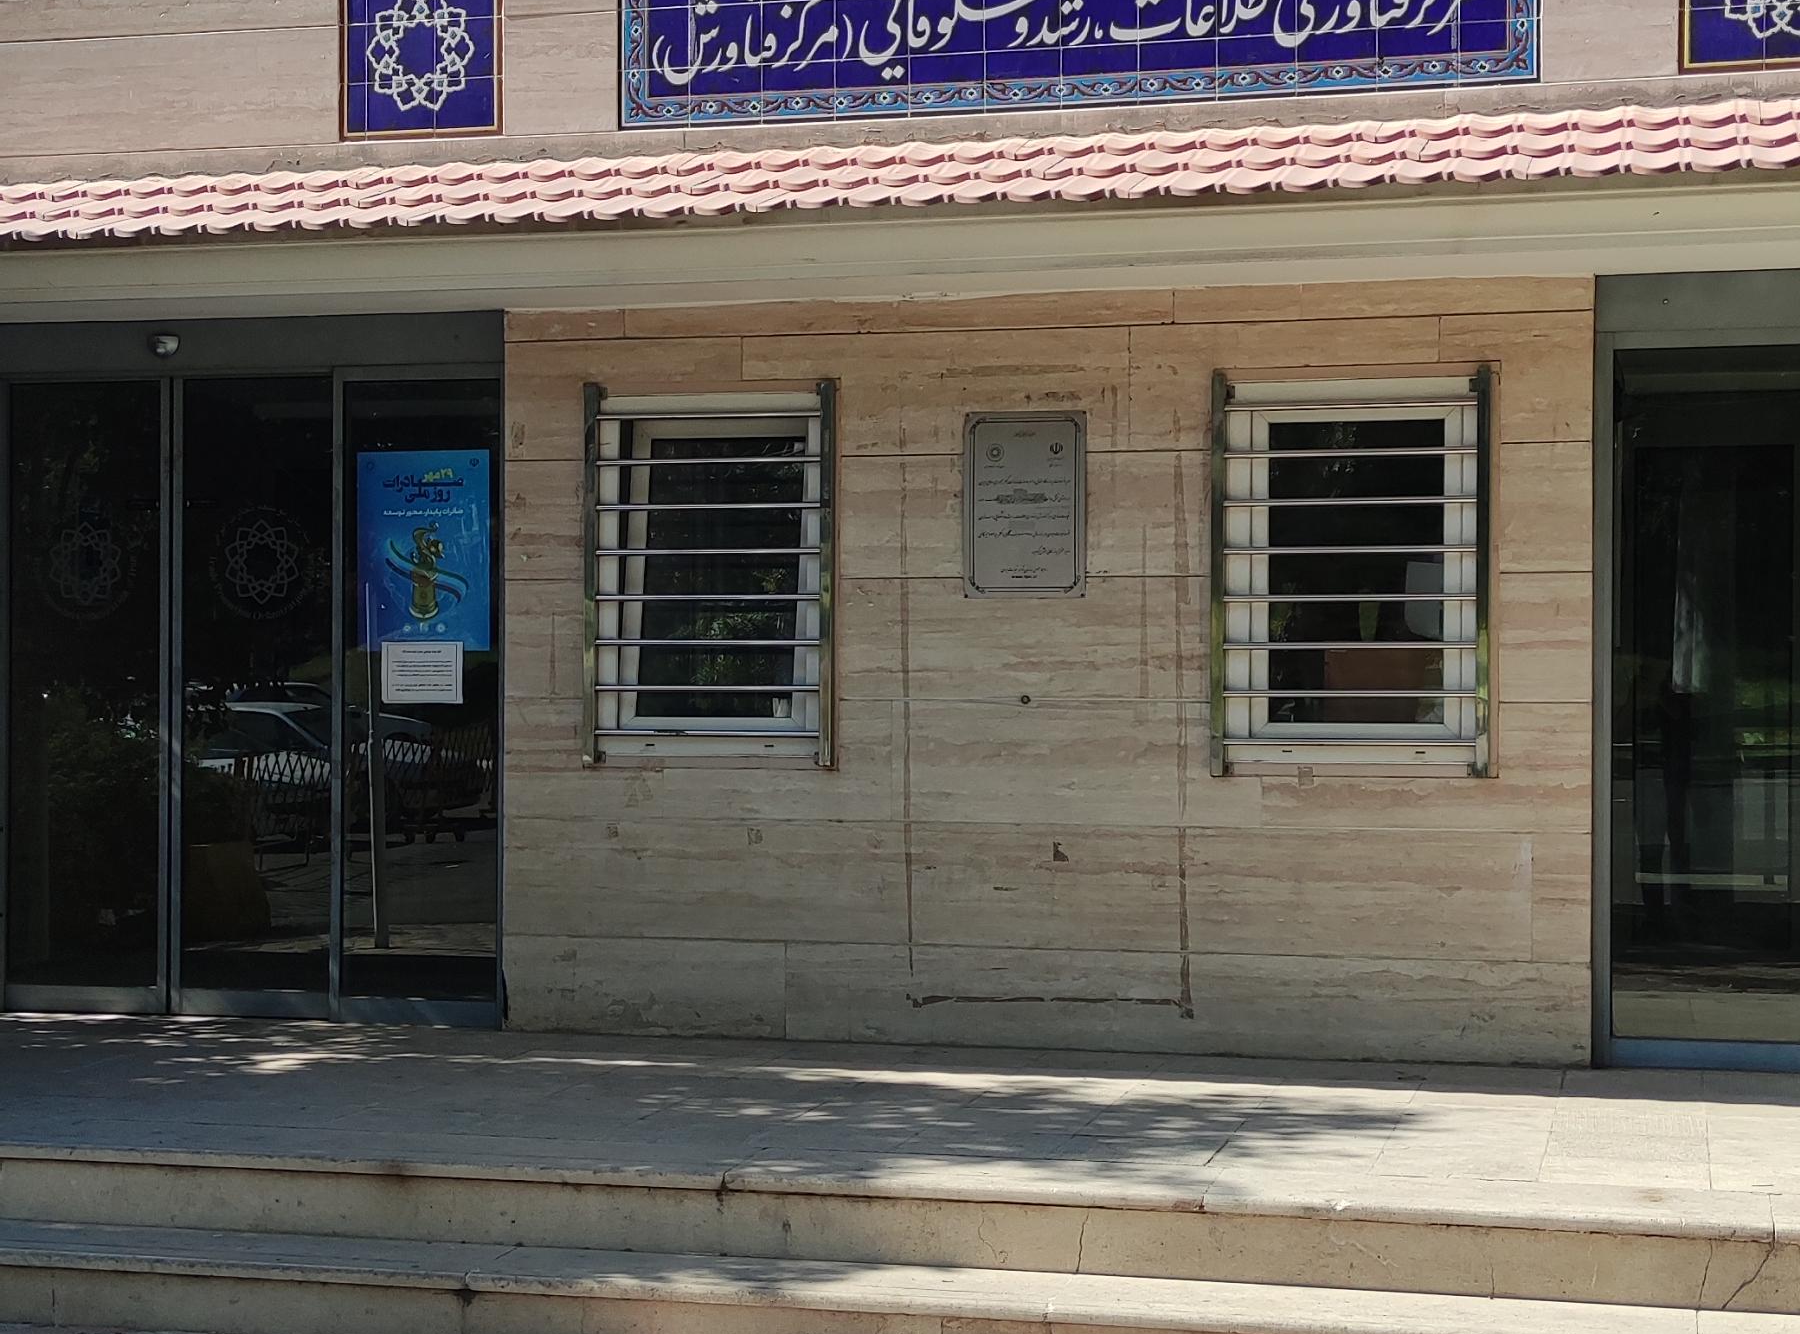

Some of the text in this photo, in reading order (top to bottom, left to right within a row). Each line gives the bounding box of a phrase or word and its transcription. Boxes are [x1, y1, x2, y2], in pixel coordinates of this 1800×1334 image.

[1007, 14, 1030, 48] و
[383, 474, 464, 492] صادرات
[404, 485, 451, 504] روز ملی
